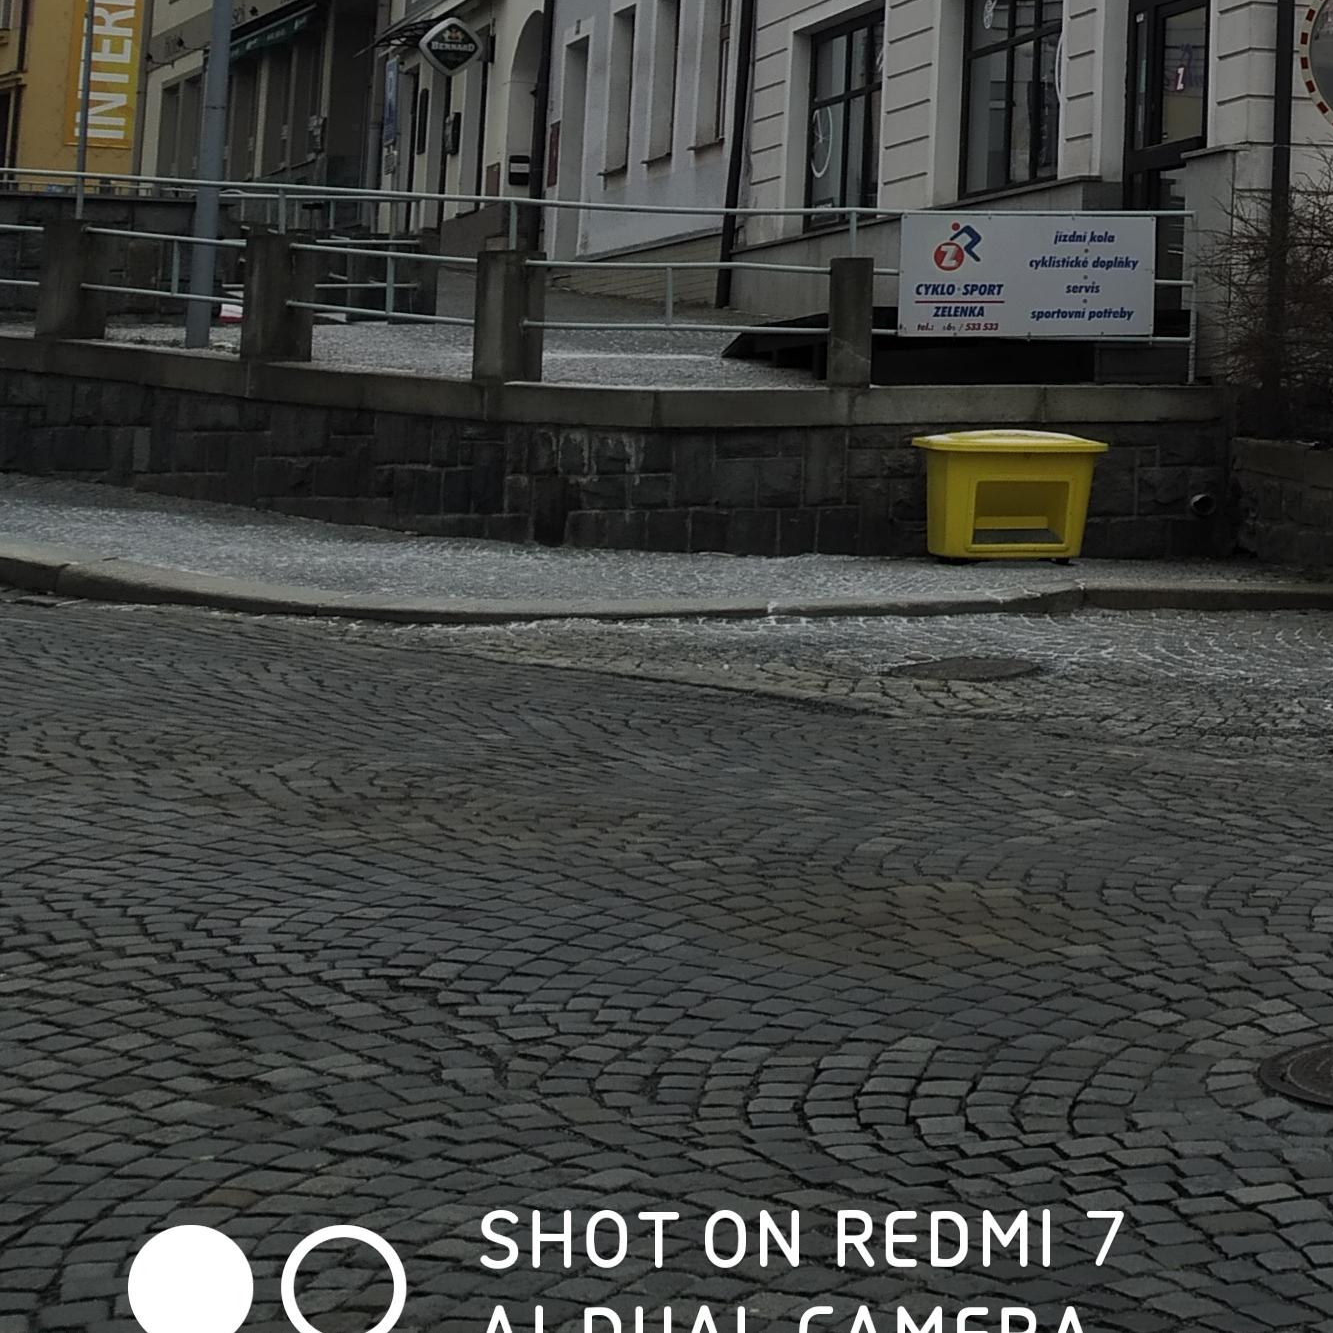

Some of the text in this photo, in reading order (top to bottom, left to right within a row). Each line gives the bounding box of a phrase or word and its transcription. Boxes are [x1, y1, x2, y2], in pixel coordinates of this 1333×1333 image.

[1089, 230, 1116, 243] kola
[1029, 255, 1139, 271] cyklistické doplňky
[1065, 281, 1101, 294] servis
[932, 305, 985, 318] ZELENKA
[1030, 306, 1134, 321] sportovní potřeby
